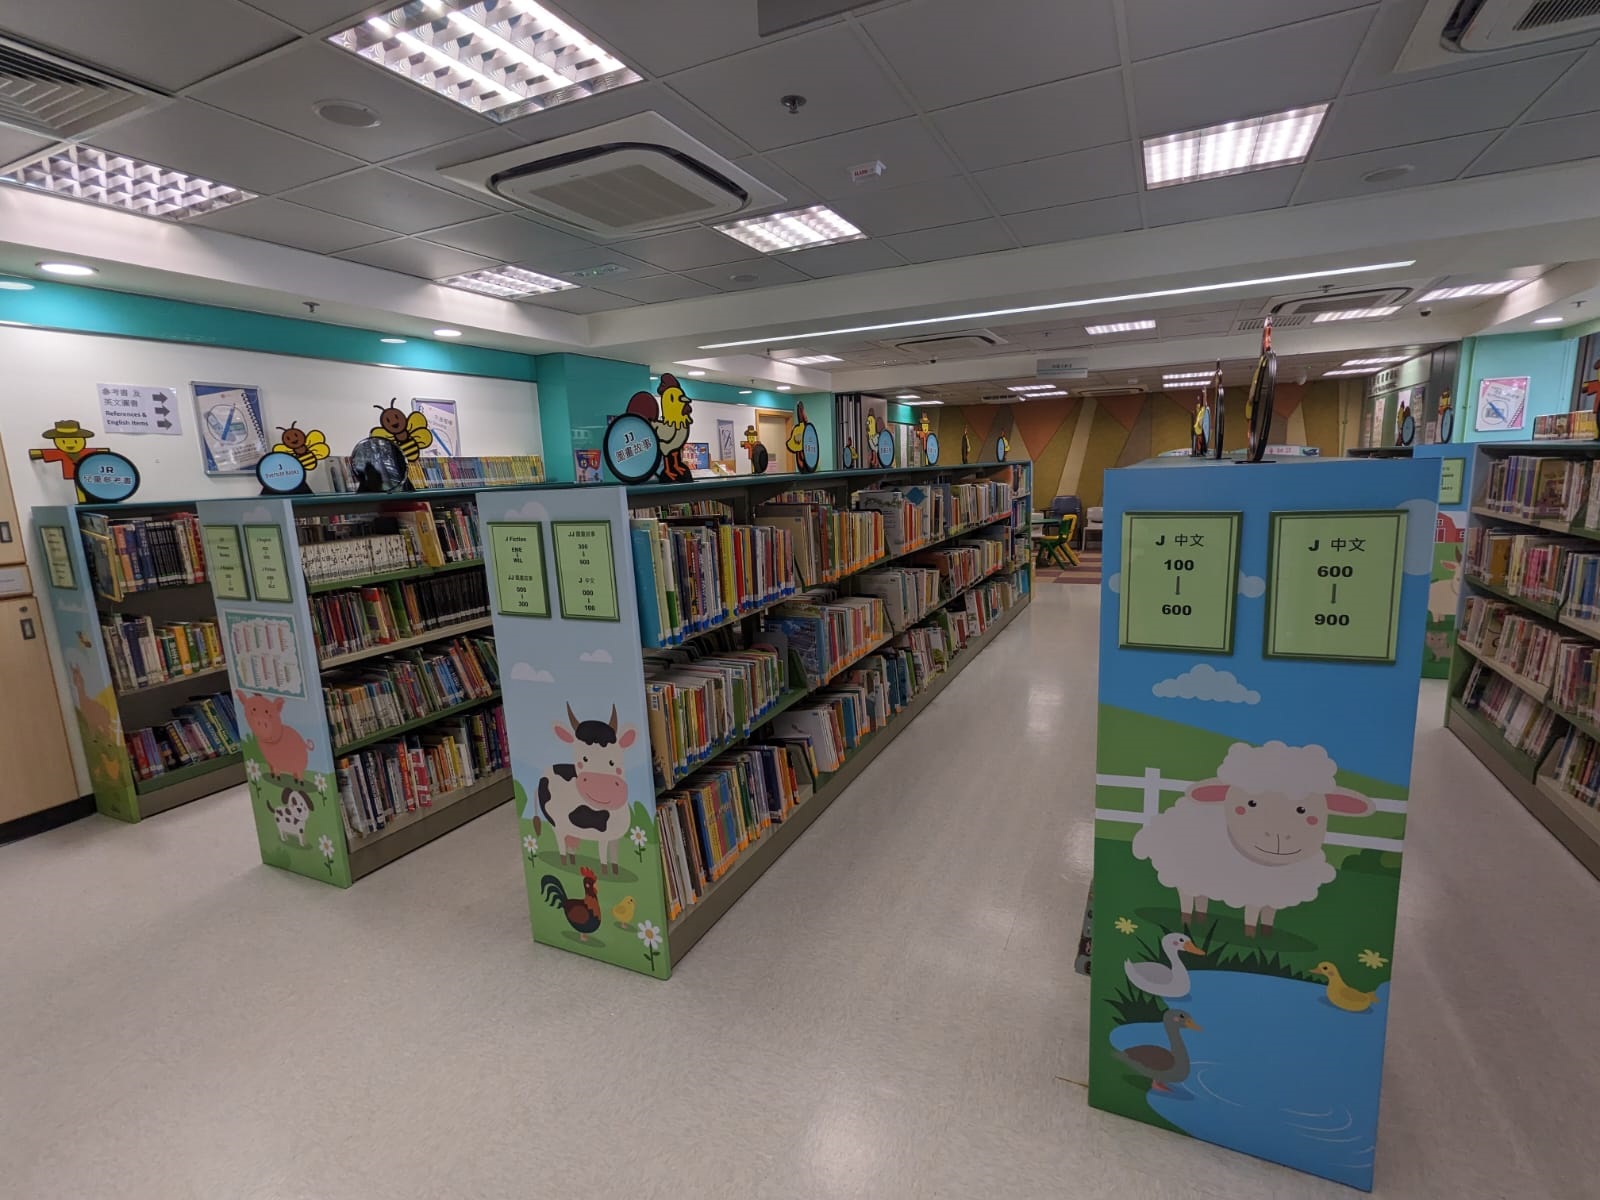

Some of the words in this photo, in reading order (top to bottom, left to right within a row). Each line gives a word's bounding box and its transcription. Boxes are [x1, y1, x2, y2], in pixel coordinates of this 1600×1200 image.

[105, 410, 140, 418] References
[624, 431, 635, 443] JJ
[615, 438, 652, 462] 圖畫故事
[1155, 535, 1165, 546] J
[1174, 534, 1204, 547] 中文
[1308, 540, 1320, 551] J
[1331, 538, 1366, 552] 中文
[1164, 559, 1194, 571] 100
[1317, 565, 1353, 577] 600
[1161, 604, 1192, 616] 600
[1314, 614, 1350, 627] 900
